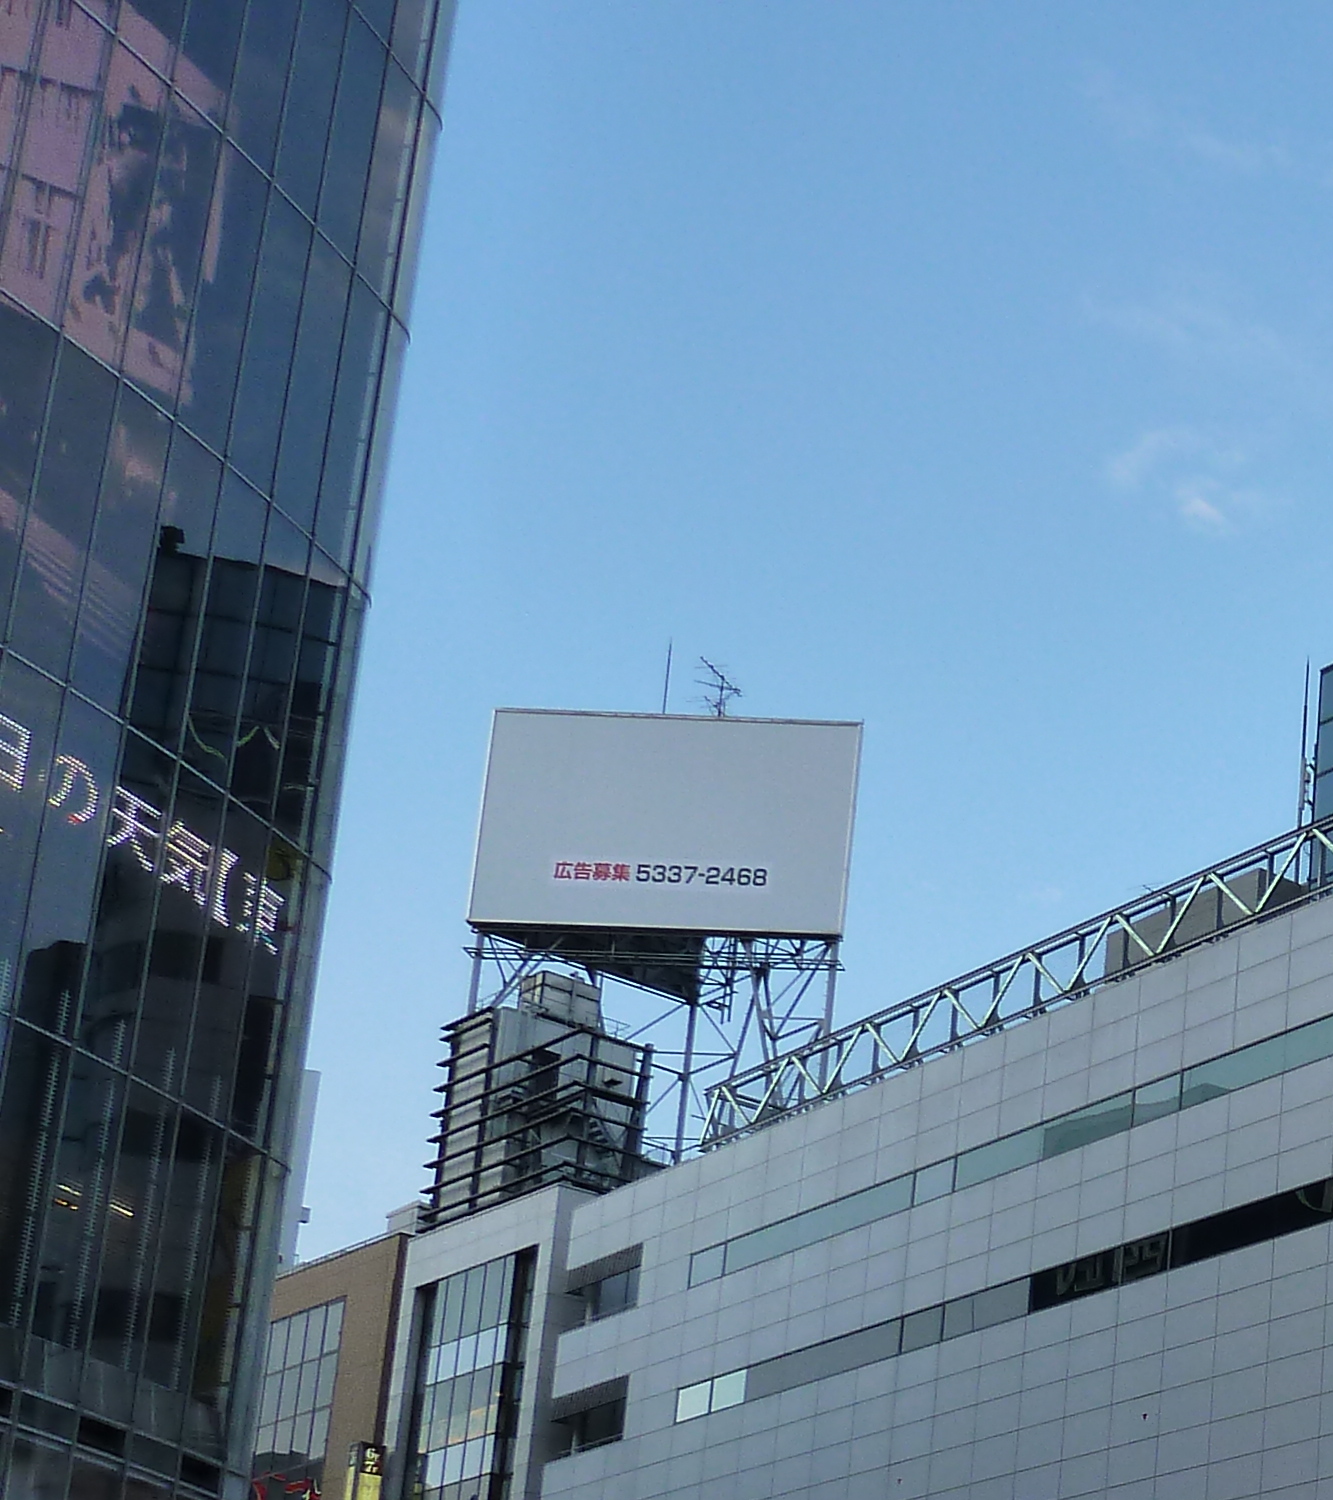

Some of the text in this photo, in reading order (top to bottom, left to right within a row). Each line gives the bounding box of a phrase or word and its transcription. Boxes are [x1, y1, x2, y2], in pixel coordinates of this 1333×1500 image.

[554, 862, 768, 886] 広告募集 5337-2468
